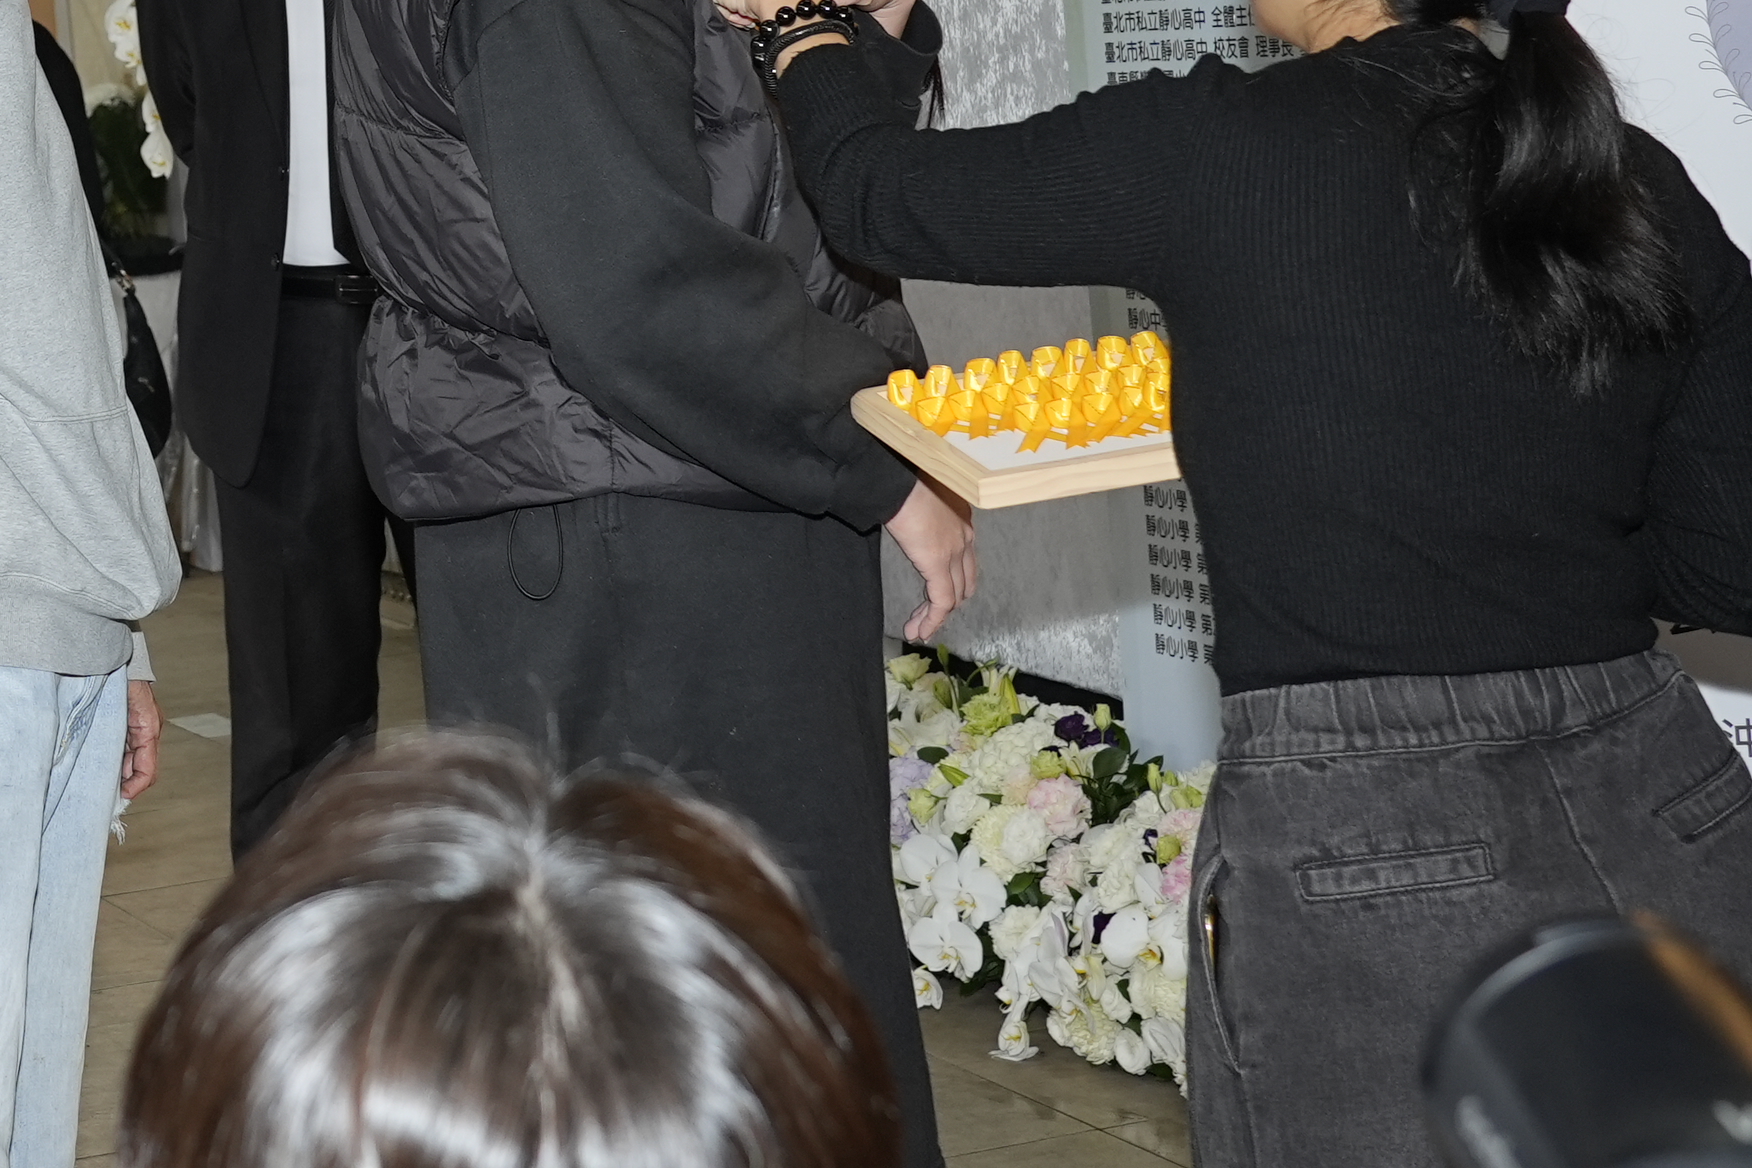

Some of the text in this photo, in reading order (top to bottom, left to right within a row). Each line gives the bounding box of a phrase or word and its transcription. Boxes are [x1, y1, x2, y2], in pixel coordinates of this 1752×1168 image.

[1102, 7, 1205, 33] 臺北市私立靜心高中
[1127, 307, 1167, 331] 靜心中
